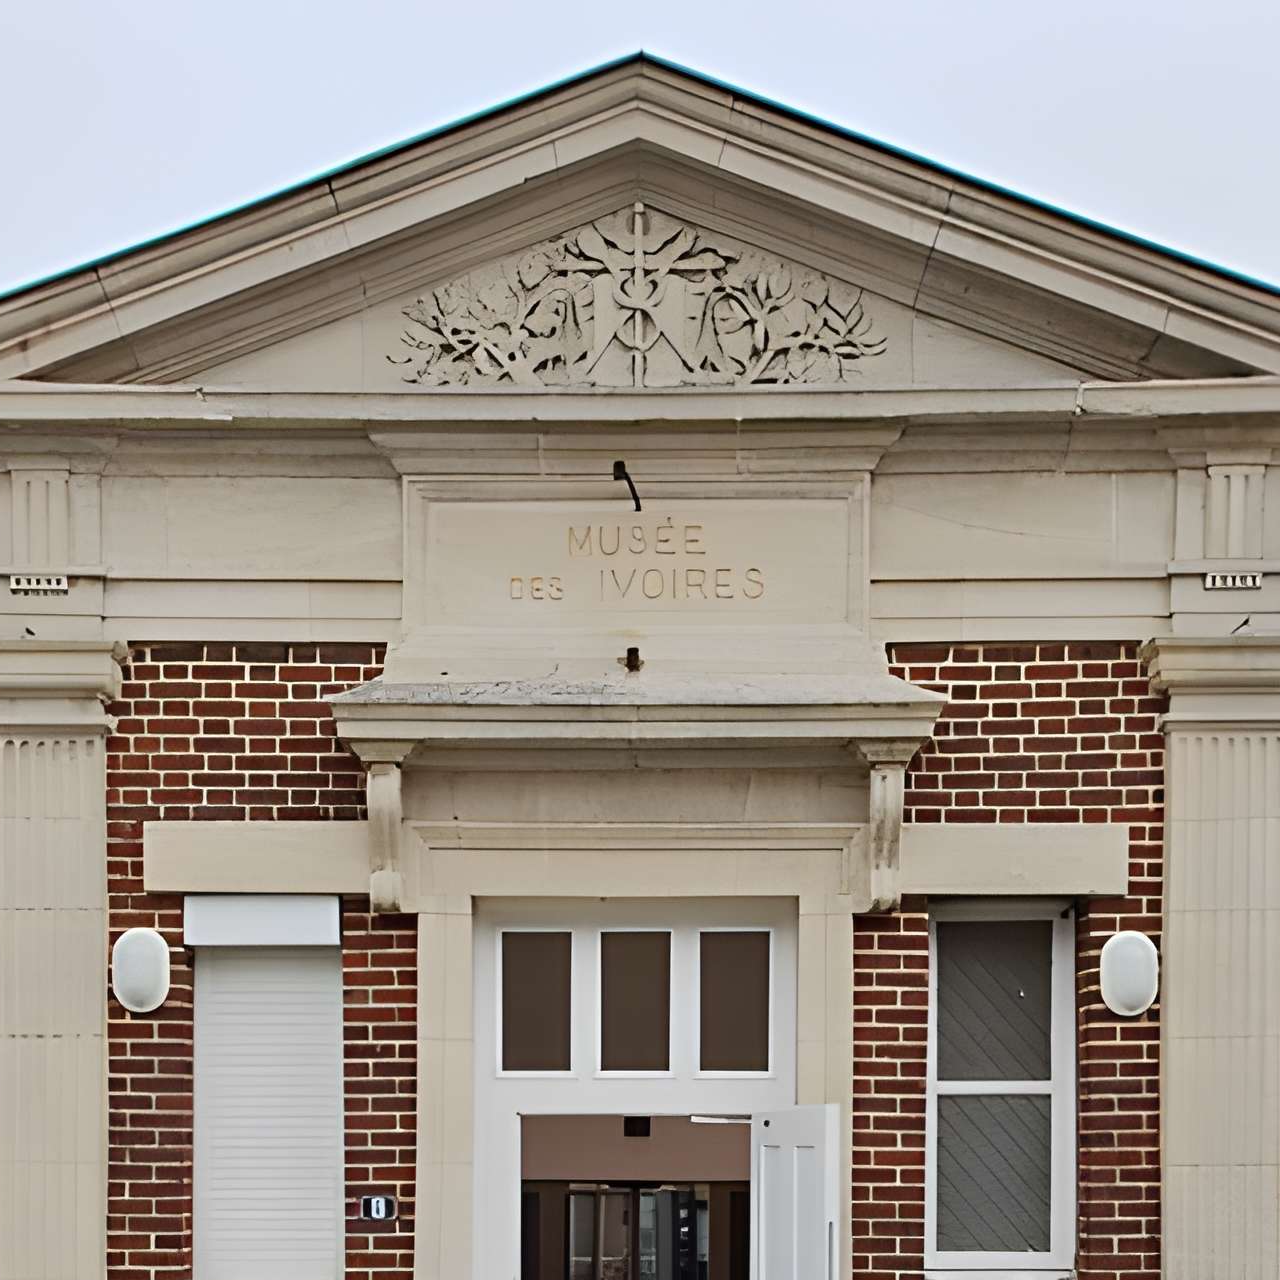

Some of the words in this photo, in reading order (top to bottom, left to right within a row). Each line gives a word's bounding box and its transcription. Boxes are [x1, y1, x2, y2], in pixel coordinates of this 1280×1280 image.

[568, 516, 707, 557] MUSÉE
[510, 576, 564, 601] DES
[599, 567, 766, 601] IVOIRES
